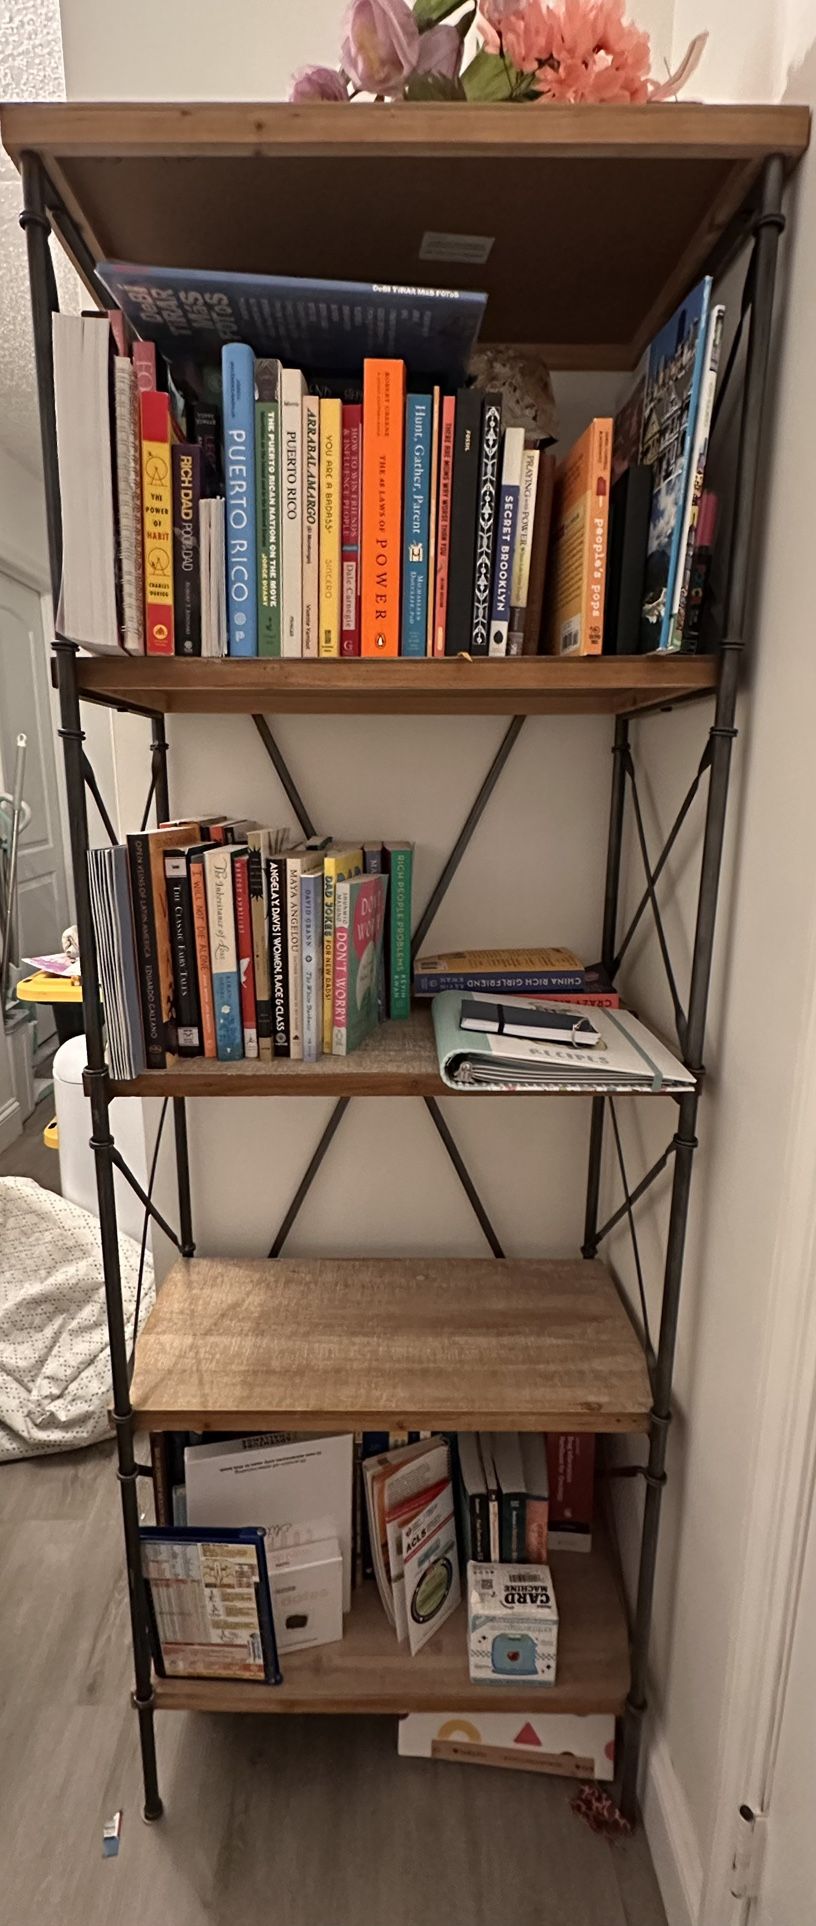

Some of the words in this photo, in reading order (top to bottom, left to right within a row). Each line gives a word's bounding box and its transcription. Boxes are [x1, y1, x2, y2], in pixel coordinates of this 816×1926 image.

[268, 411, 276, 433] THE
[414, 405, 427, 442] Hunt,
[443, 423, 452, 443] THERE
[307, 408, 317, 469] ARRABAL
[325, 435, 333, 457] YOU
[351, 427, 359, 451] HOW
[268, 433, 276, 473] PUERTO
[286, 431, 297, 484] PUERTO
[351, 455, 358, 468] TO
[180, 456, 193, 487] RICH
[228, 429, 248, 530] PUERTO
[325, 460, 333, 478] ARE
[413, 444, 425, 492] Gather,
[524, 455, 535, 498] PRAYING
[151, 493, 163, 502] THE
[268, 474, 276, 505] RICAN
[307, 470, 317, 525] AMARGO
[145, 507, 169, 516] POWER
[181, 489, 193, 520] DAD
[286, 487, 298, 520] RICO
[412, 494, 424, 534] Parent
[441, 499, 449, 523] WORSE
[153, 519, 163, 528] OF
[268, 507, 277, 543] NATION
[379, 520, 386, 533] OF
[501, 495, 514, 541] SECRET
[519, 511, 530, 546] POWER
[147, 531, 170, 542] HABIT
[440, 524, 448, 541] THAN
[269, 544, 277, 558] ON
[439, 543, 447, 557] YOU
[593, 517, 606, 578] people's
[182, 550, 193, 572] DAD
[231, 539, 249, 602] RICO
[269, 560, 277, 579] THE
[346, 564, 355, 586] Dale
[375, 538, 388, 621] POWER
[497, 545, 510, 611] BROOKLYN
[269, 580, 277, 608] MOVE
[591, 584, 603, 617] pops
[344, 587, 355, 629] Carnegie
[135, 841, 146, 863] OPEN
[214, 858, 228, 879] The
[396, 854, 405, 879] RICH
[138, 887, 148, 898] OF
[192, 881, 202, 902] WILL
[269, 862, 280, 899] ANGELA
[290, 869, 298, 898] MAYA
[324, 875, 334, 898] DAD
[172, 886, 182, 902] THE
[215, 882, 225, 929] Inheritance
[396, 881, 405, 920] PEOPLE
[139, 900, 149, 923] LATIN
[174, 906, 185, 940] CLASSIC
[195, 904, 204, 920] NOT
[271, 907, 281, 932] DAVIS
[324, 902, 334, 936] JOKES
[196, 927, 206, 939] DIE
[215, 929, 226, 938] of
[290, 902, 299, 953] ANGELOU
[142, 924, 152, 958] AMERICA
[336, 932, 348, 972] DON'T
[396, 921, 405, 972] PROBLEMS
[177, 945, 186, 968] FAIRY
[199, 943, 209, 971] ALONE
[273, 937, 283, 974] WOMEN,
[144, 965, 156, 1002] EDUARDO
[274, 975, 284, 998] RACE
[466, 978, 523, 988] GIRLFRIEND
[525, 977, 549, 988] RICH
[551, 976, 582, 987] CHINA
[335, 977, 347, 1023] WORRY
[147, 1003, 158, 1039] GALEANO
[276, 1006, 285, 1031] CLASS
[529, 1048, 611, 1066] RECIPES
[406, 1527, 428, 1554] ACLS
[504, 1585, 548, 1593] MACHINE
[504, 1592, 551, 1605] CARD
